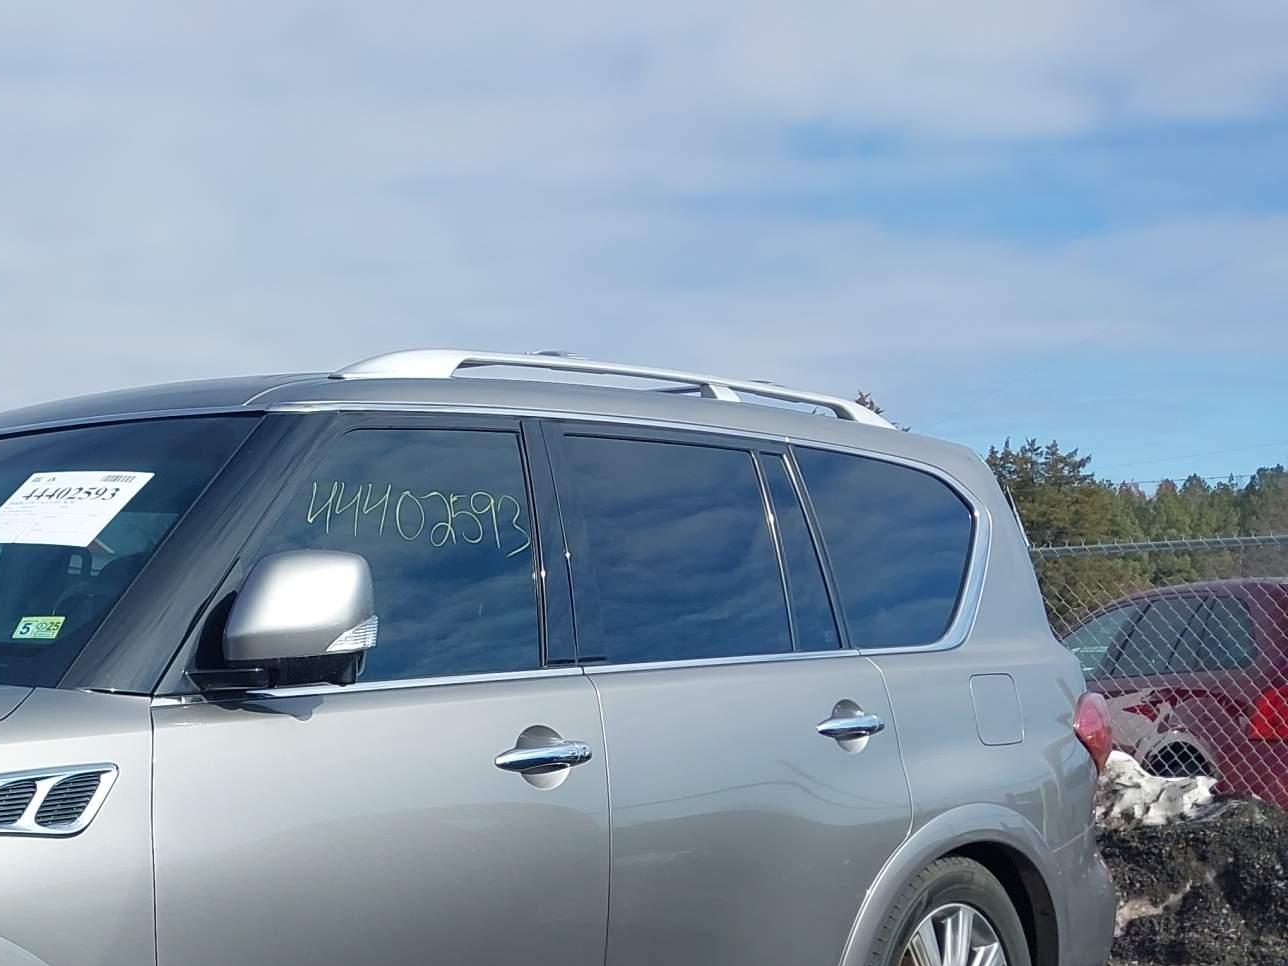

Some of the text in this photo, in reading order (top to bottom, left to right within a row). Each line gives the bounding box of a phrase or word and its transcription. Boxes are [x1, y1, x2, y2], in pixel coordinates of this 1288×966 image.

[22, 487, 120, 501] 44402593
[306, 481, 531, 557] 44402593
[20, 622, 33, 635] 5
